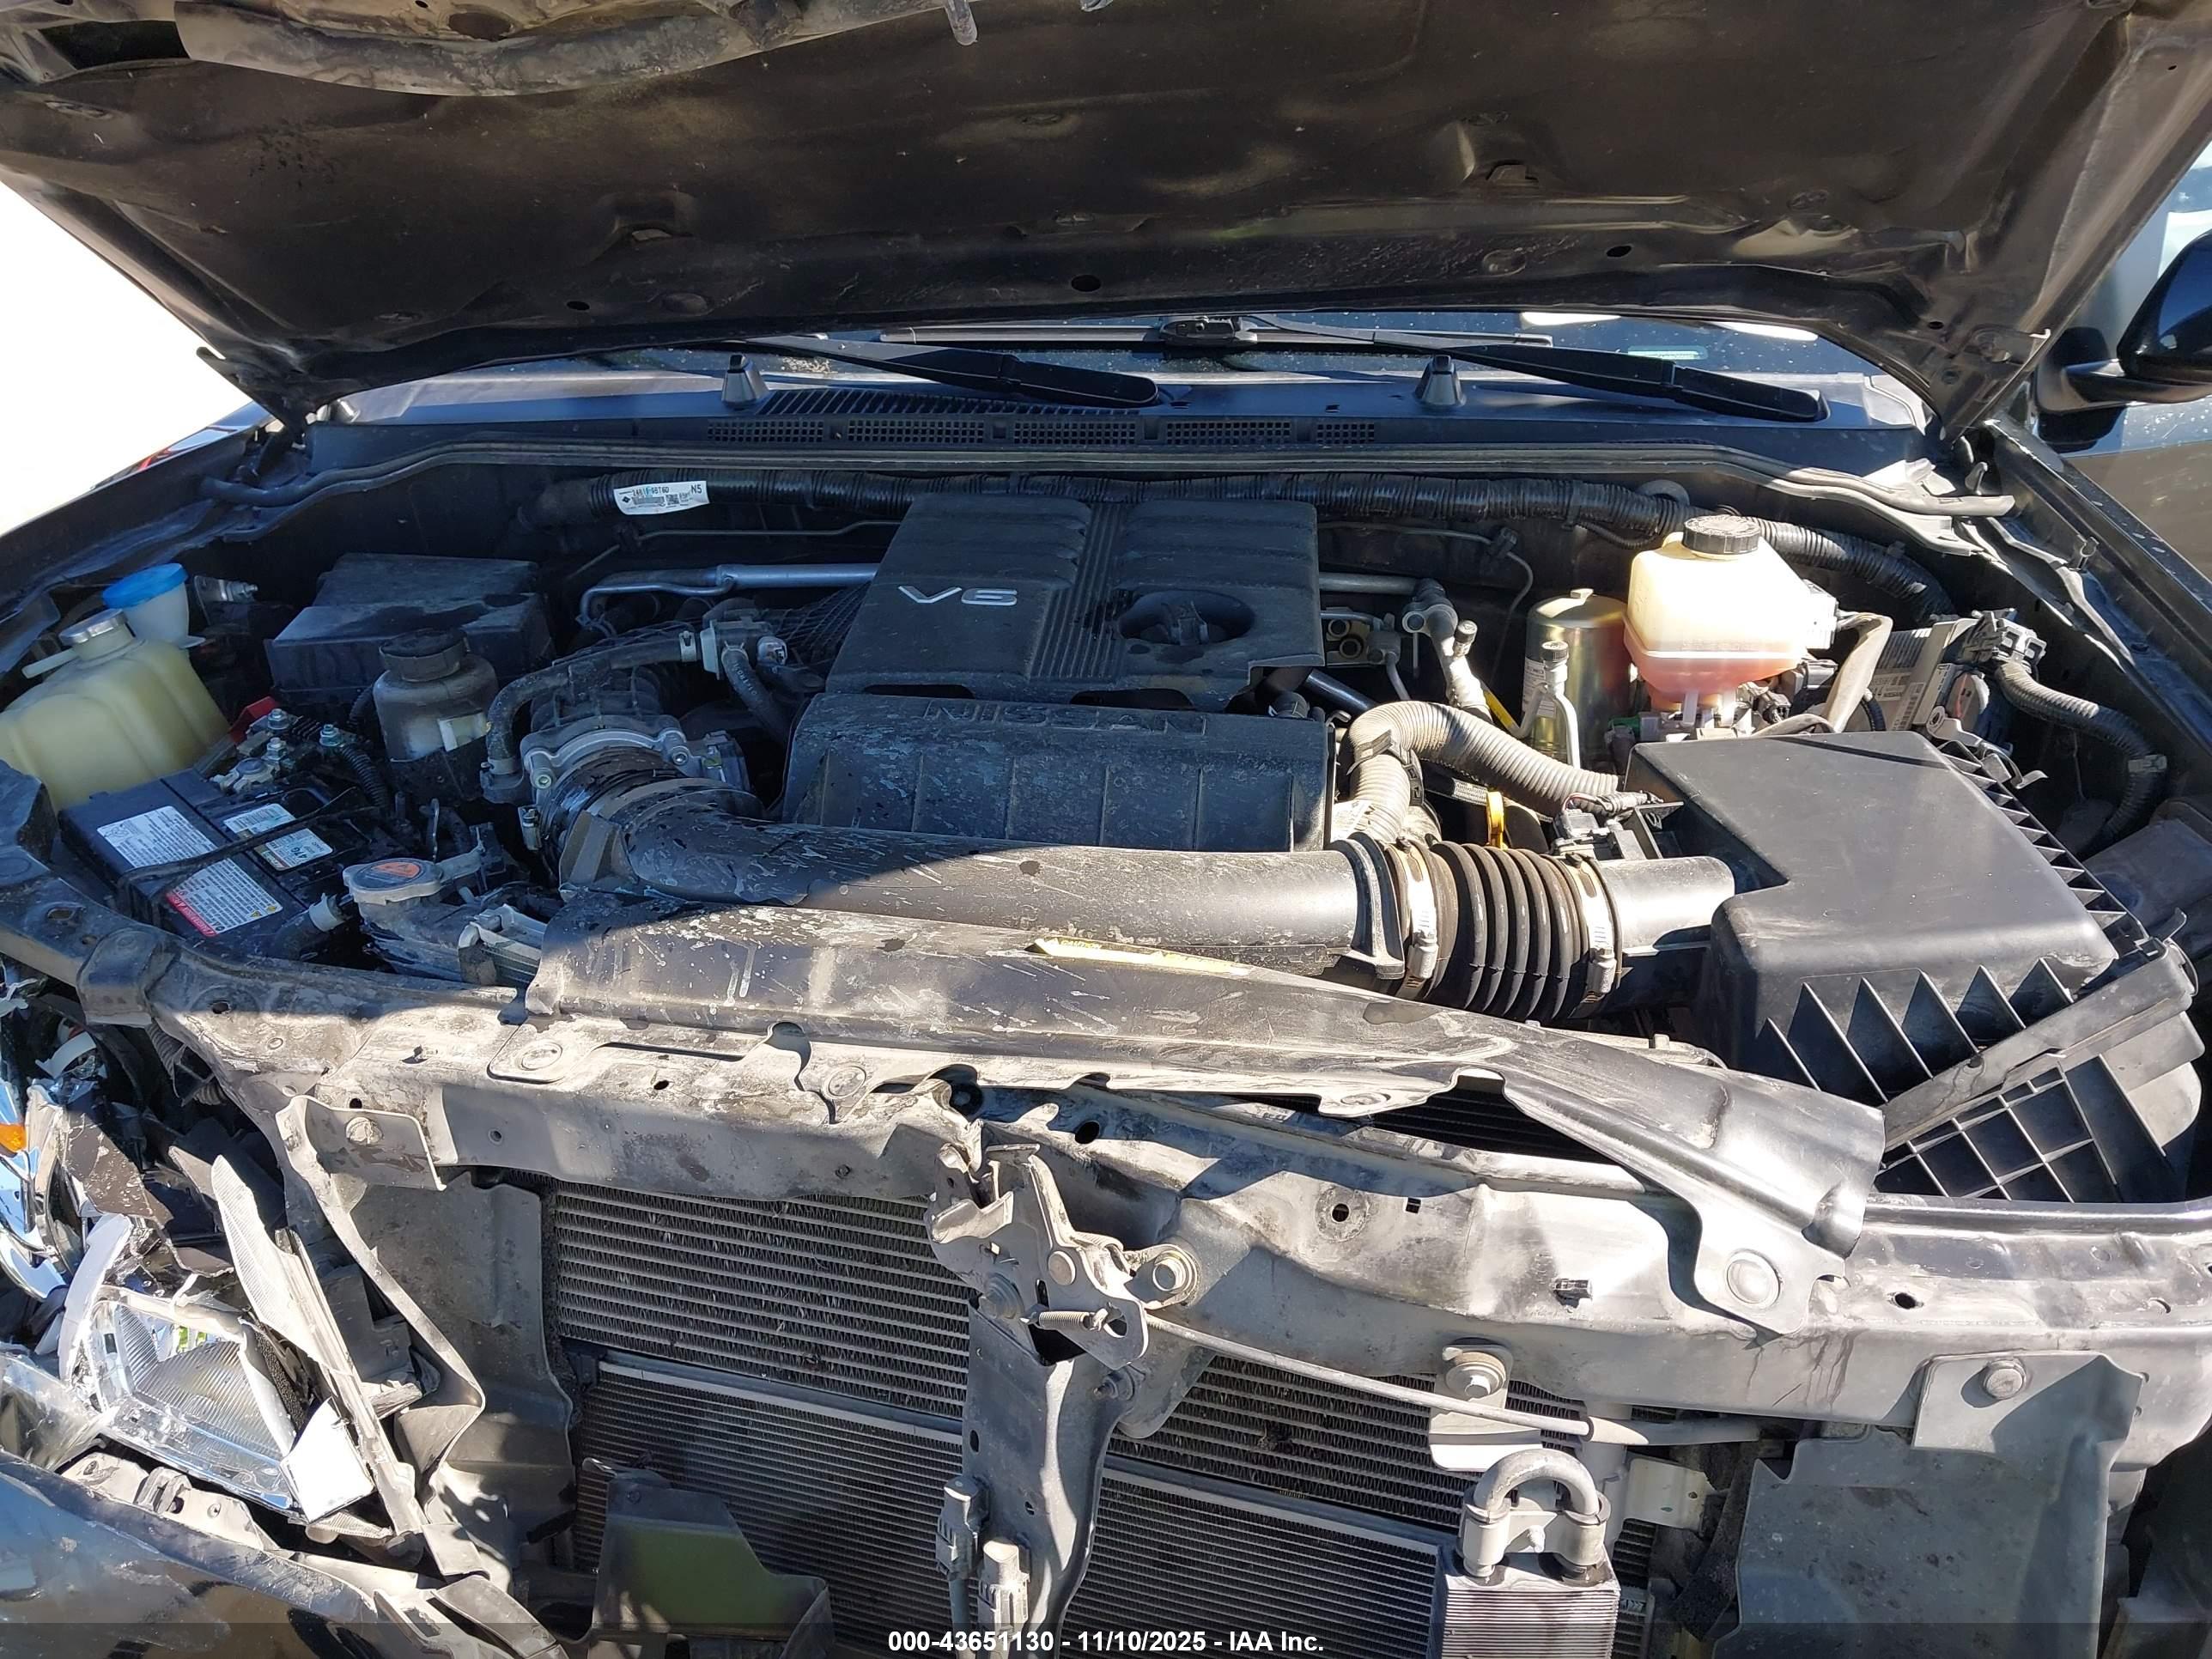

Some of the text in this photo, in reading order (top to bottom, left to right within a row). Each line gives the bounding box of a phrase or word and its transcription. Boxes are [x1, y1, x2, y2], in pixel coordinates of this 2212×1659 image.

[690, 484, 702, 495] N5
[898, 586, 1018, 606] V6
[922, 699, 1208, 736] NISSAN
